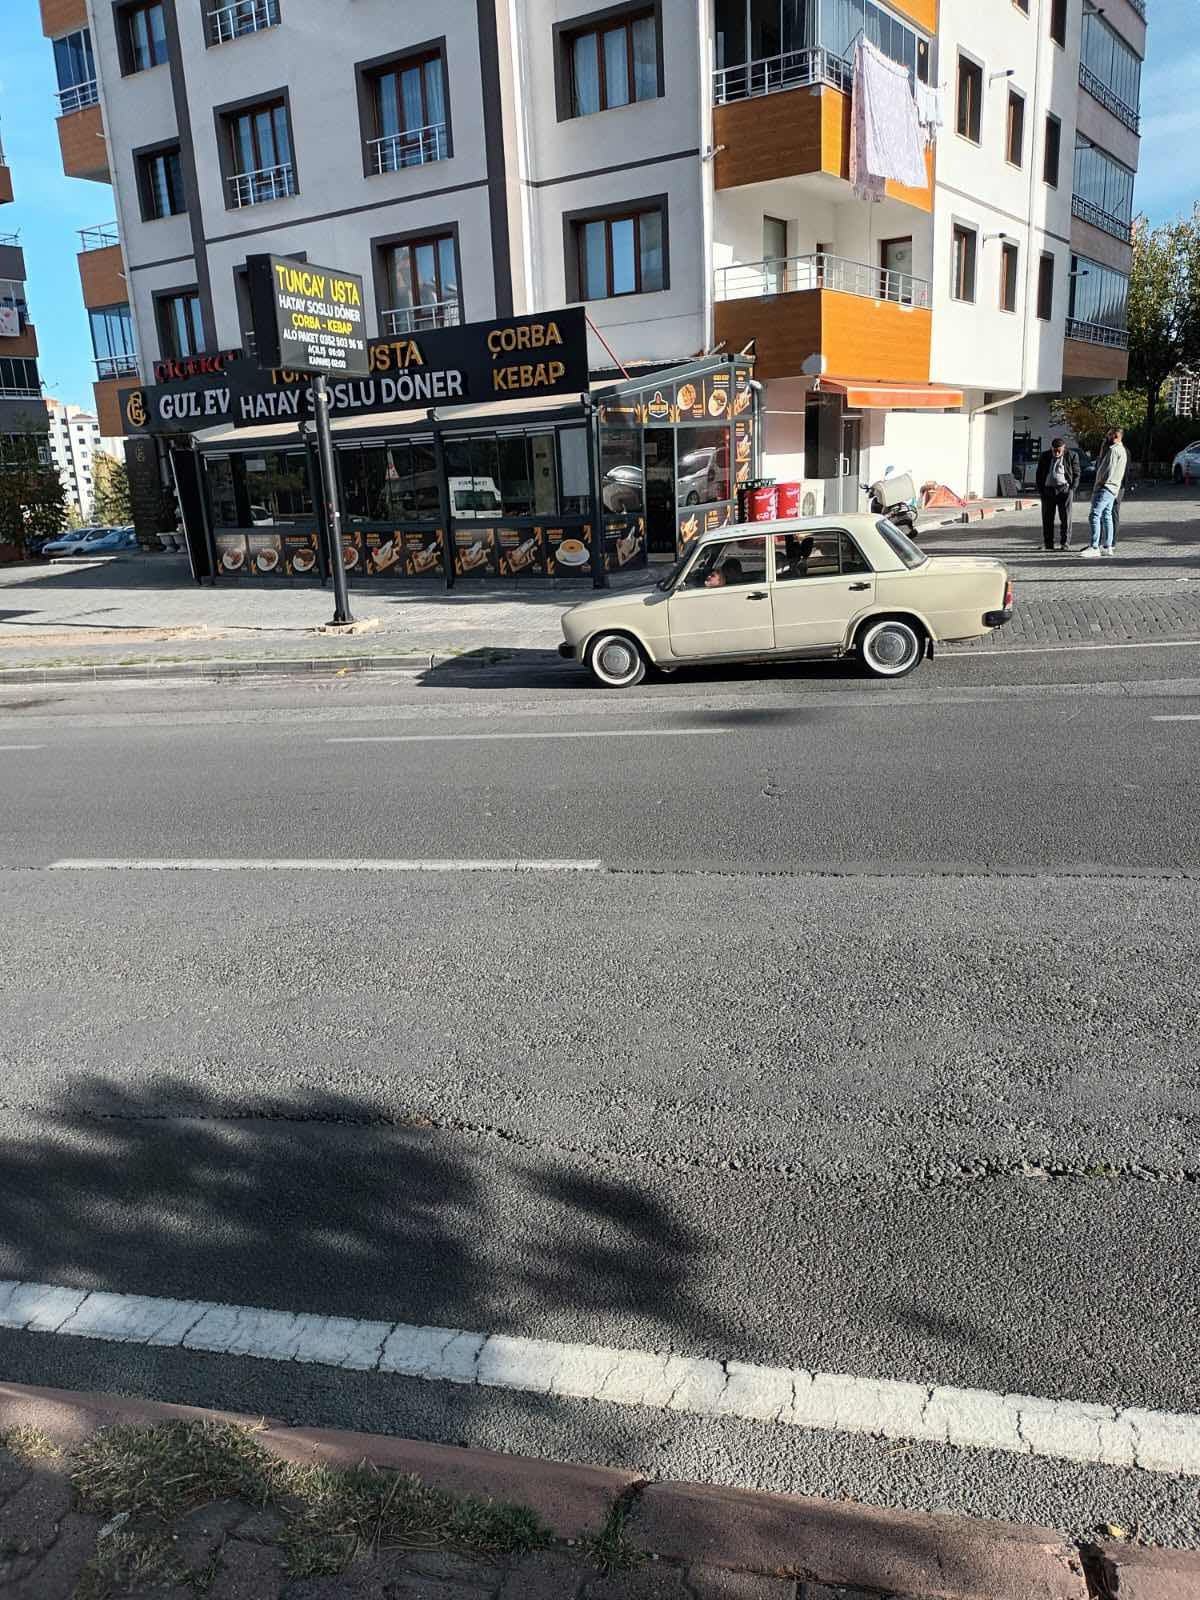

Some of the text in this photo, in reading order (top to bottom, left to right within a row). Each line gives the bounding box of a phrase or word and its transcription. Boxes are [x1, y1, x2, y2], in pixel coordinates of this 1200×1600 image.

[275, 265, 361, 306] TUNCAY USTA
[278, 294, 361, 322] HATAY SOSLU DÖNER
[283, 328, 298, 341] ALO
[297, 330, 319, 344] PAKET
[291, 313, 321, 330] ÇORBA
[326, 318, 353, 335] KEBAP
[487, 321, 563, 359] ÇORBA
[492, 361, 566, 391] KEBAP
[239, 368, 464, 420] HATAY SOSLU DÖNER
